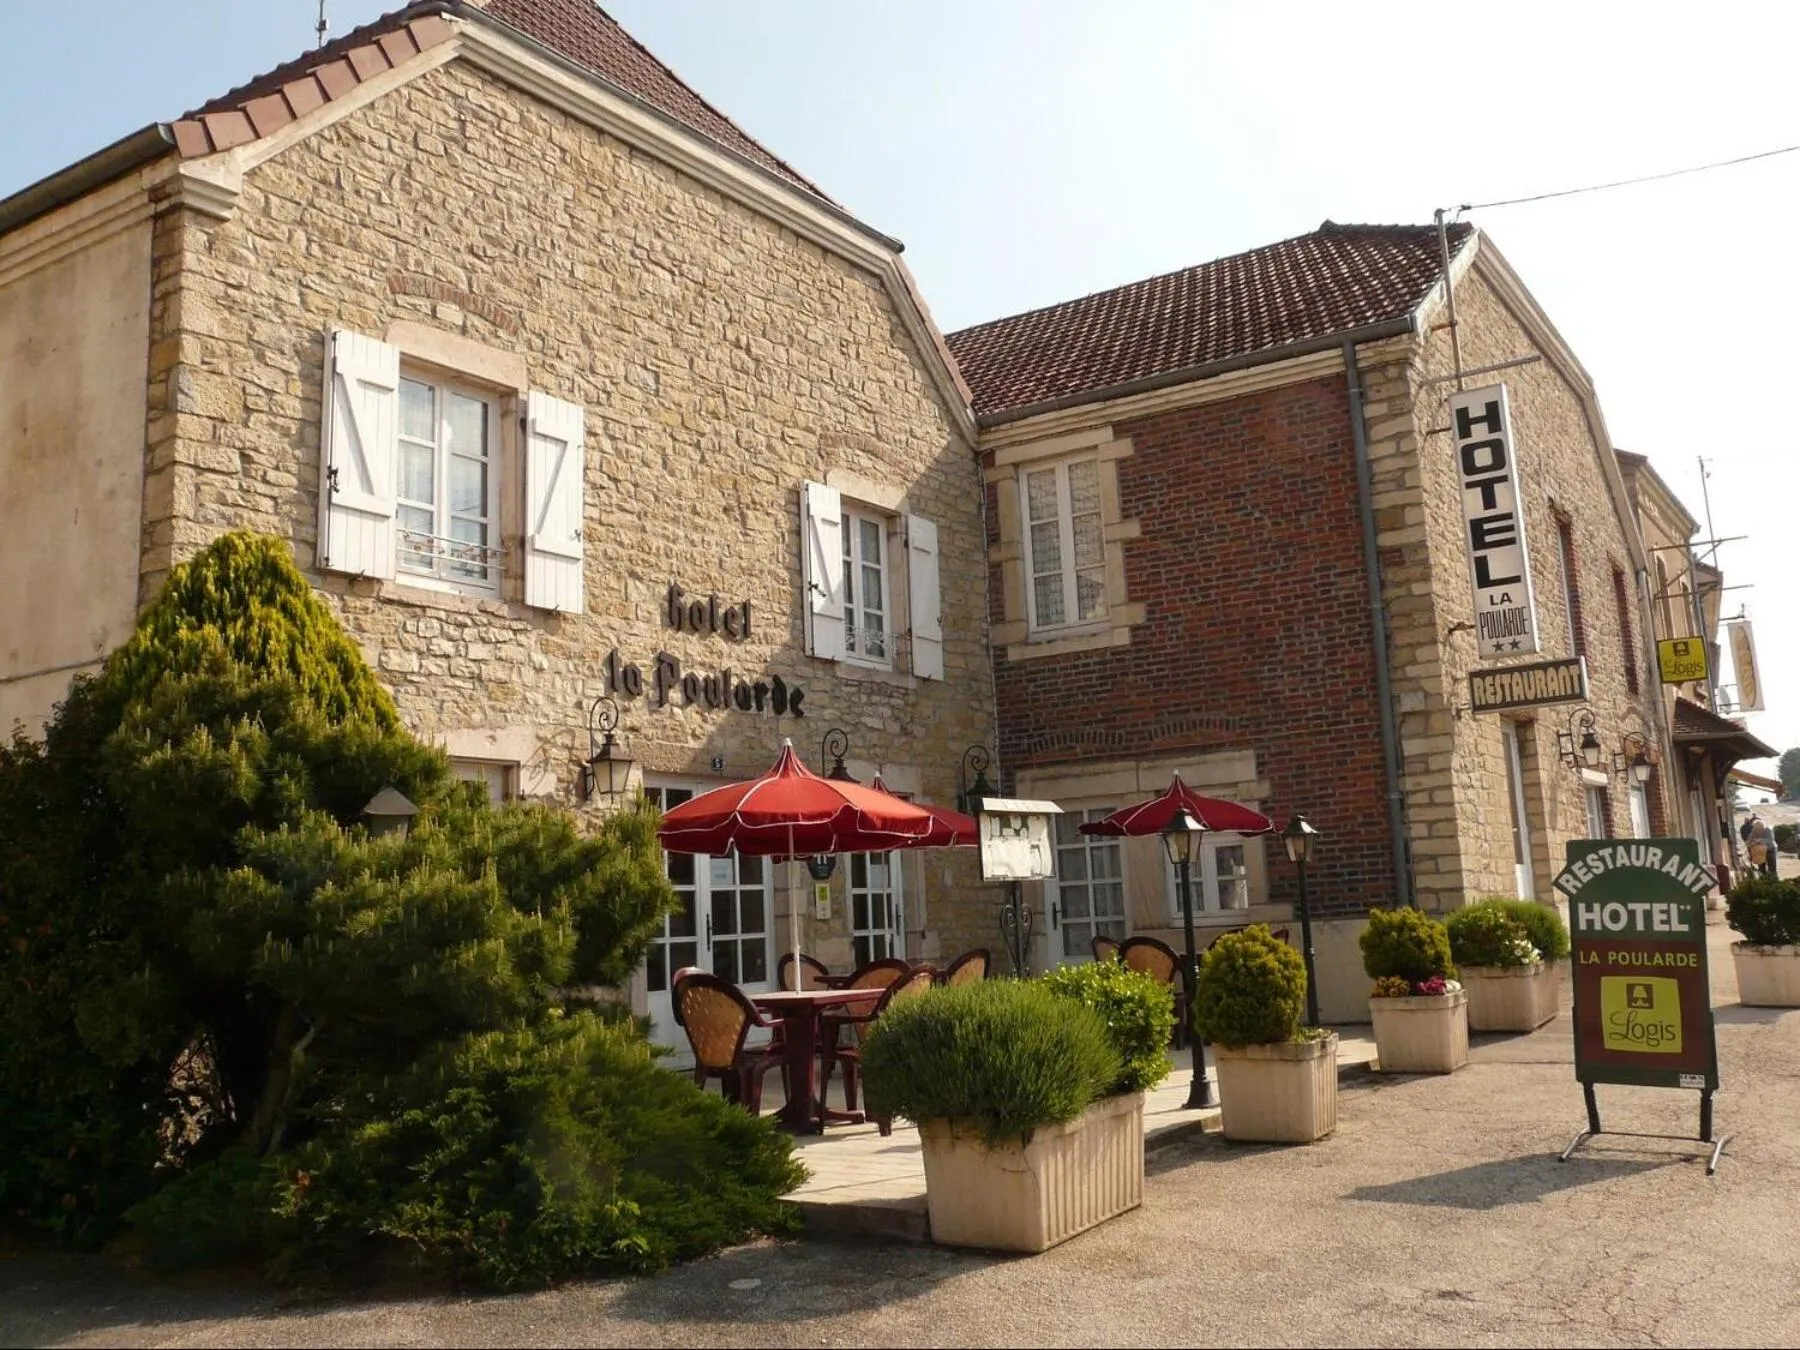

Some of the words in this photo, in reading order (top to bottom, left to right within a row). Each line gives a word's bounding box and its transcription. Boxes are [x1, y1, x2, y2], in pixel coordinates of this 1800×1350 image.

[1455, 400, 1522, 589] HOTEL
[1489, 592, 1513, 606] LA
[1479, 606, 1530, 641] POULARDE
[609, 649, 643, 697] la
[656, 650, 806, 719] Poularde
[1664, 655, 1705, 677] Logis
[1472, 664, 1581, 706] RESTAURANT
[1558, 845, 1713, 895] RESTAURANT
[1577, 902, 1690, 933] HOTEL
[1579, 952, 1600, 965] LA
[1608, 952, 1699, 968] POULARDE
[1609, 1010, 1677, 1048] Logis
